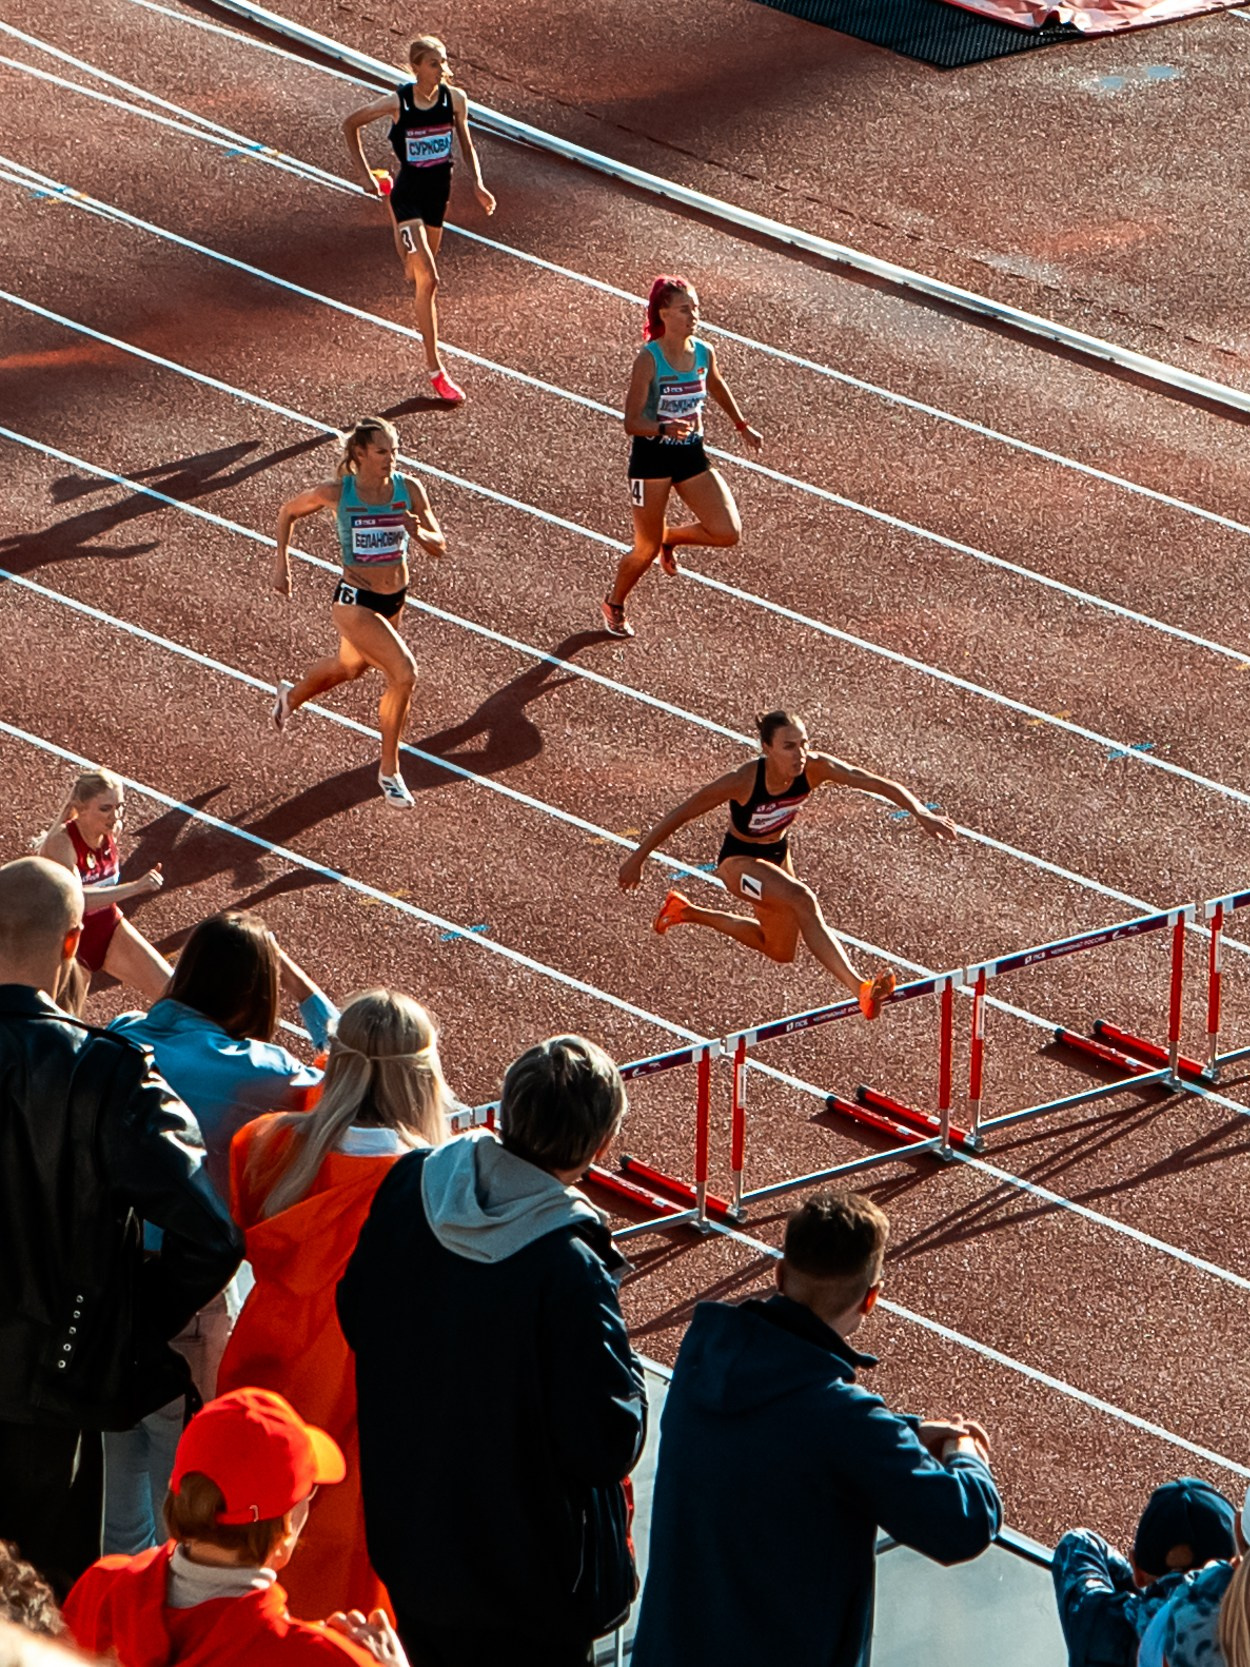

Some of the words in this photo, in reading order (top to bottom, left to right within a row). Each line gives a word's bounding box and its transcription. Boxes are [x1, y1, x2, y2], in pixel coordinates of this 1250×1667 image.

[409, 137, 449, 156] СУРКОВА
[402, 229, 413, 252] 3
[633, 480, 642, 504] 4
[341, 586, 355, 604] 6
[743, 878, 760, 896] 7
